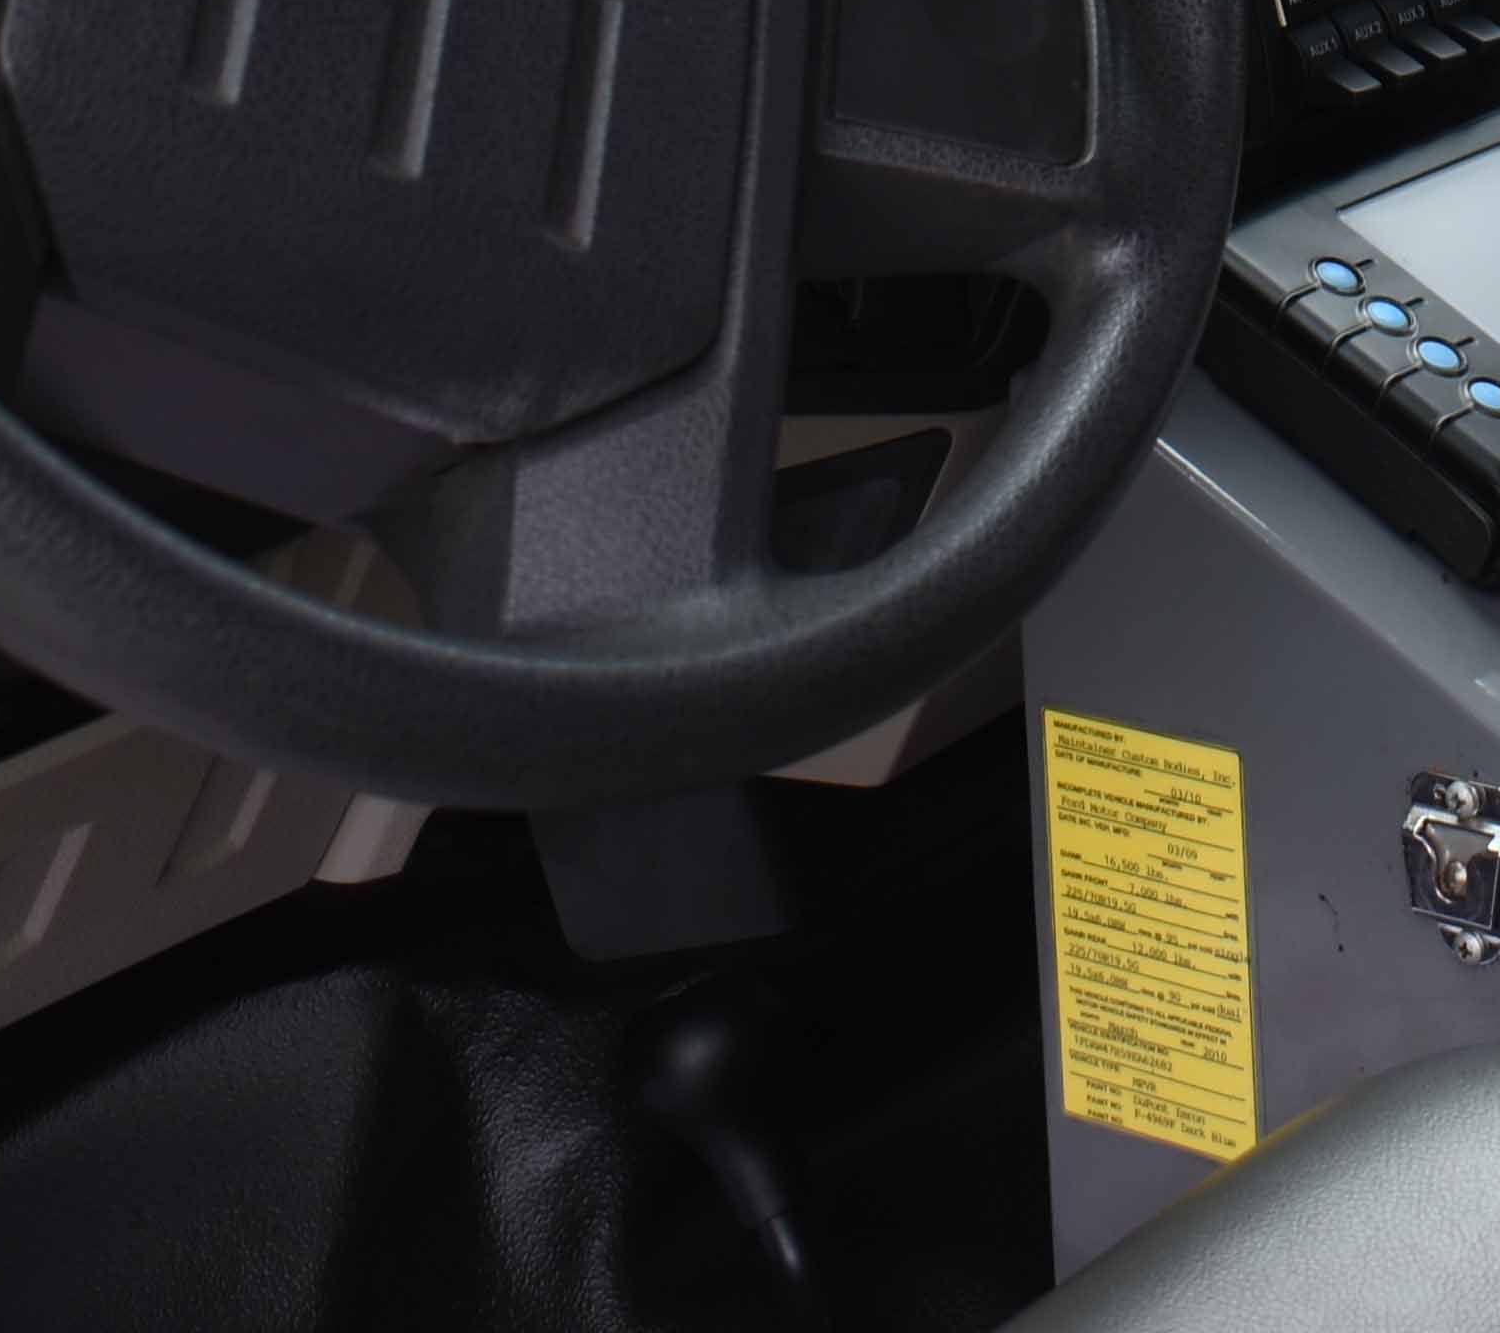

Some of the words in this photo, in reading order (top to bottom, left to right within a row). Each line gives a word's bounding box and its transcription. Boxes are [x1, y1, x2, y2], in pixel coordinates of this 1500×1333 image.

[1398, 7, 1418, 26] AUX
[1354, 24, 1372, 41] AUX
[1308, 40, 1330, 58] AUX
[1054, 719, 1113, 741] MANUFACTURED
[1055, 749, 1073, 762] DATE
[1058, 734, 1117, 756] Maintainer
[1121, 750, 1159, 767] Custom
[1212, 771, 1236, 786] Inc.
[1057, 781, 1102, 800] INCOMPLETE
[1104, 792, 1134, 808] VEHICLE
[1136, 799, 1196, 824] MANUFACTURED
[1058, 812, 1076, 824] DATE
[1061, 795, 1086, 810] Ford
[1089, 802, 1119, 818] Motor
[1124, 811, 1168, 834] Company
[1084, 874, 1109, 886] FRONT
